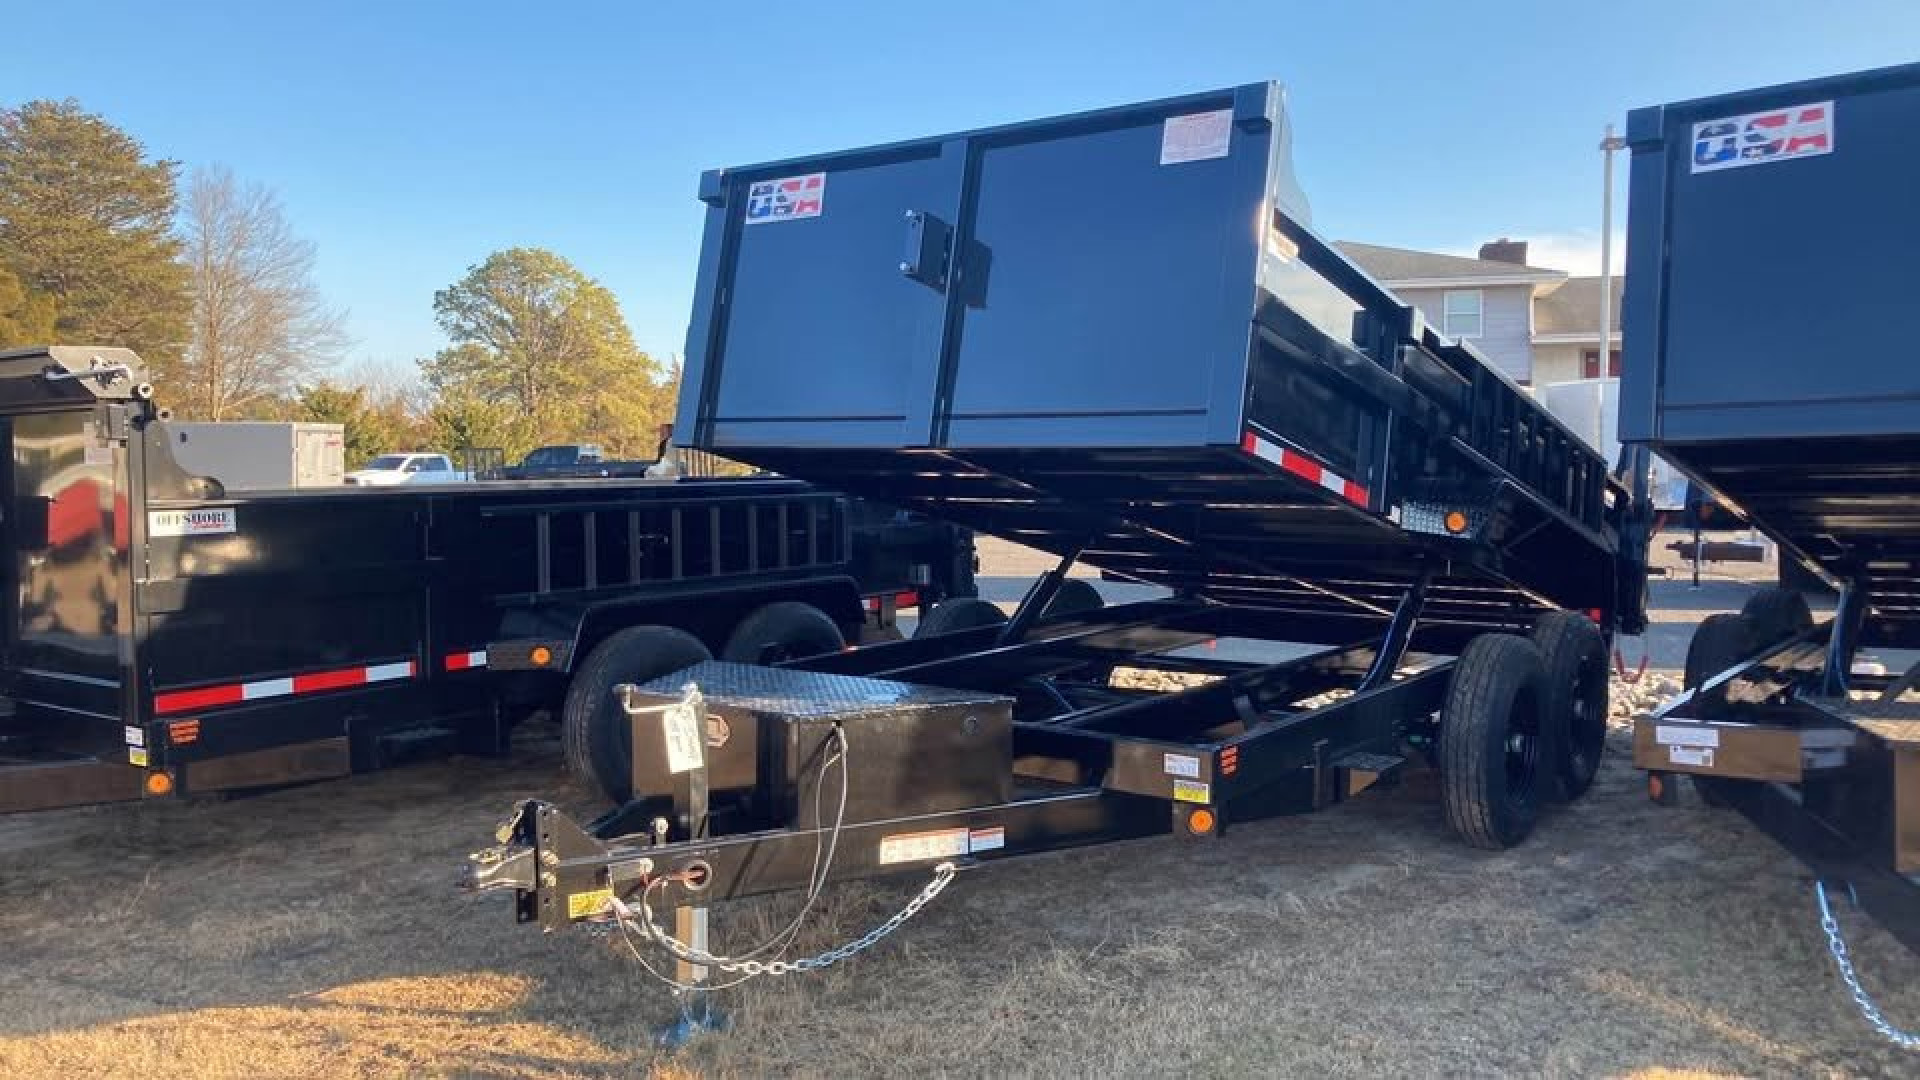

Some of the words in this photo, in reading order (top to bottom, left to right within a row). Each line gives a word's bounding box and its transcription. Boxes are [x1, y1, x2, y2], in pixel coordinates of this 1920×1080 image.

[1694, 106, 1828, 166] USA
[748, 175, 822, 219] USA
[155, 512, 230, 526] OFFSHORE
